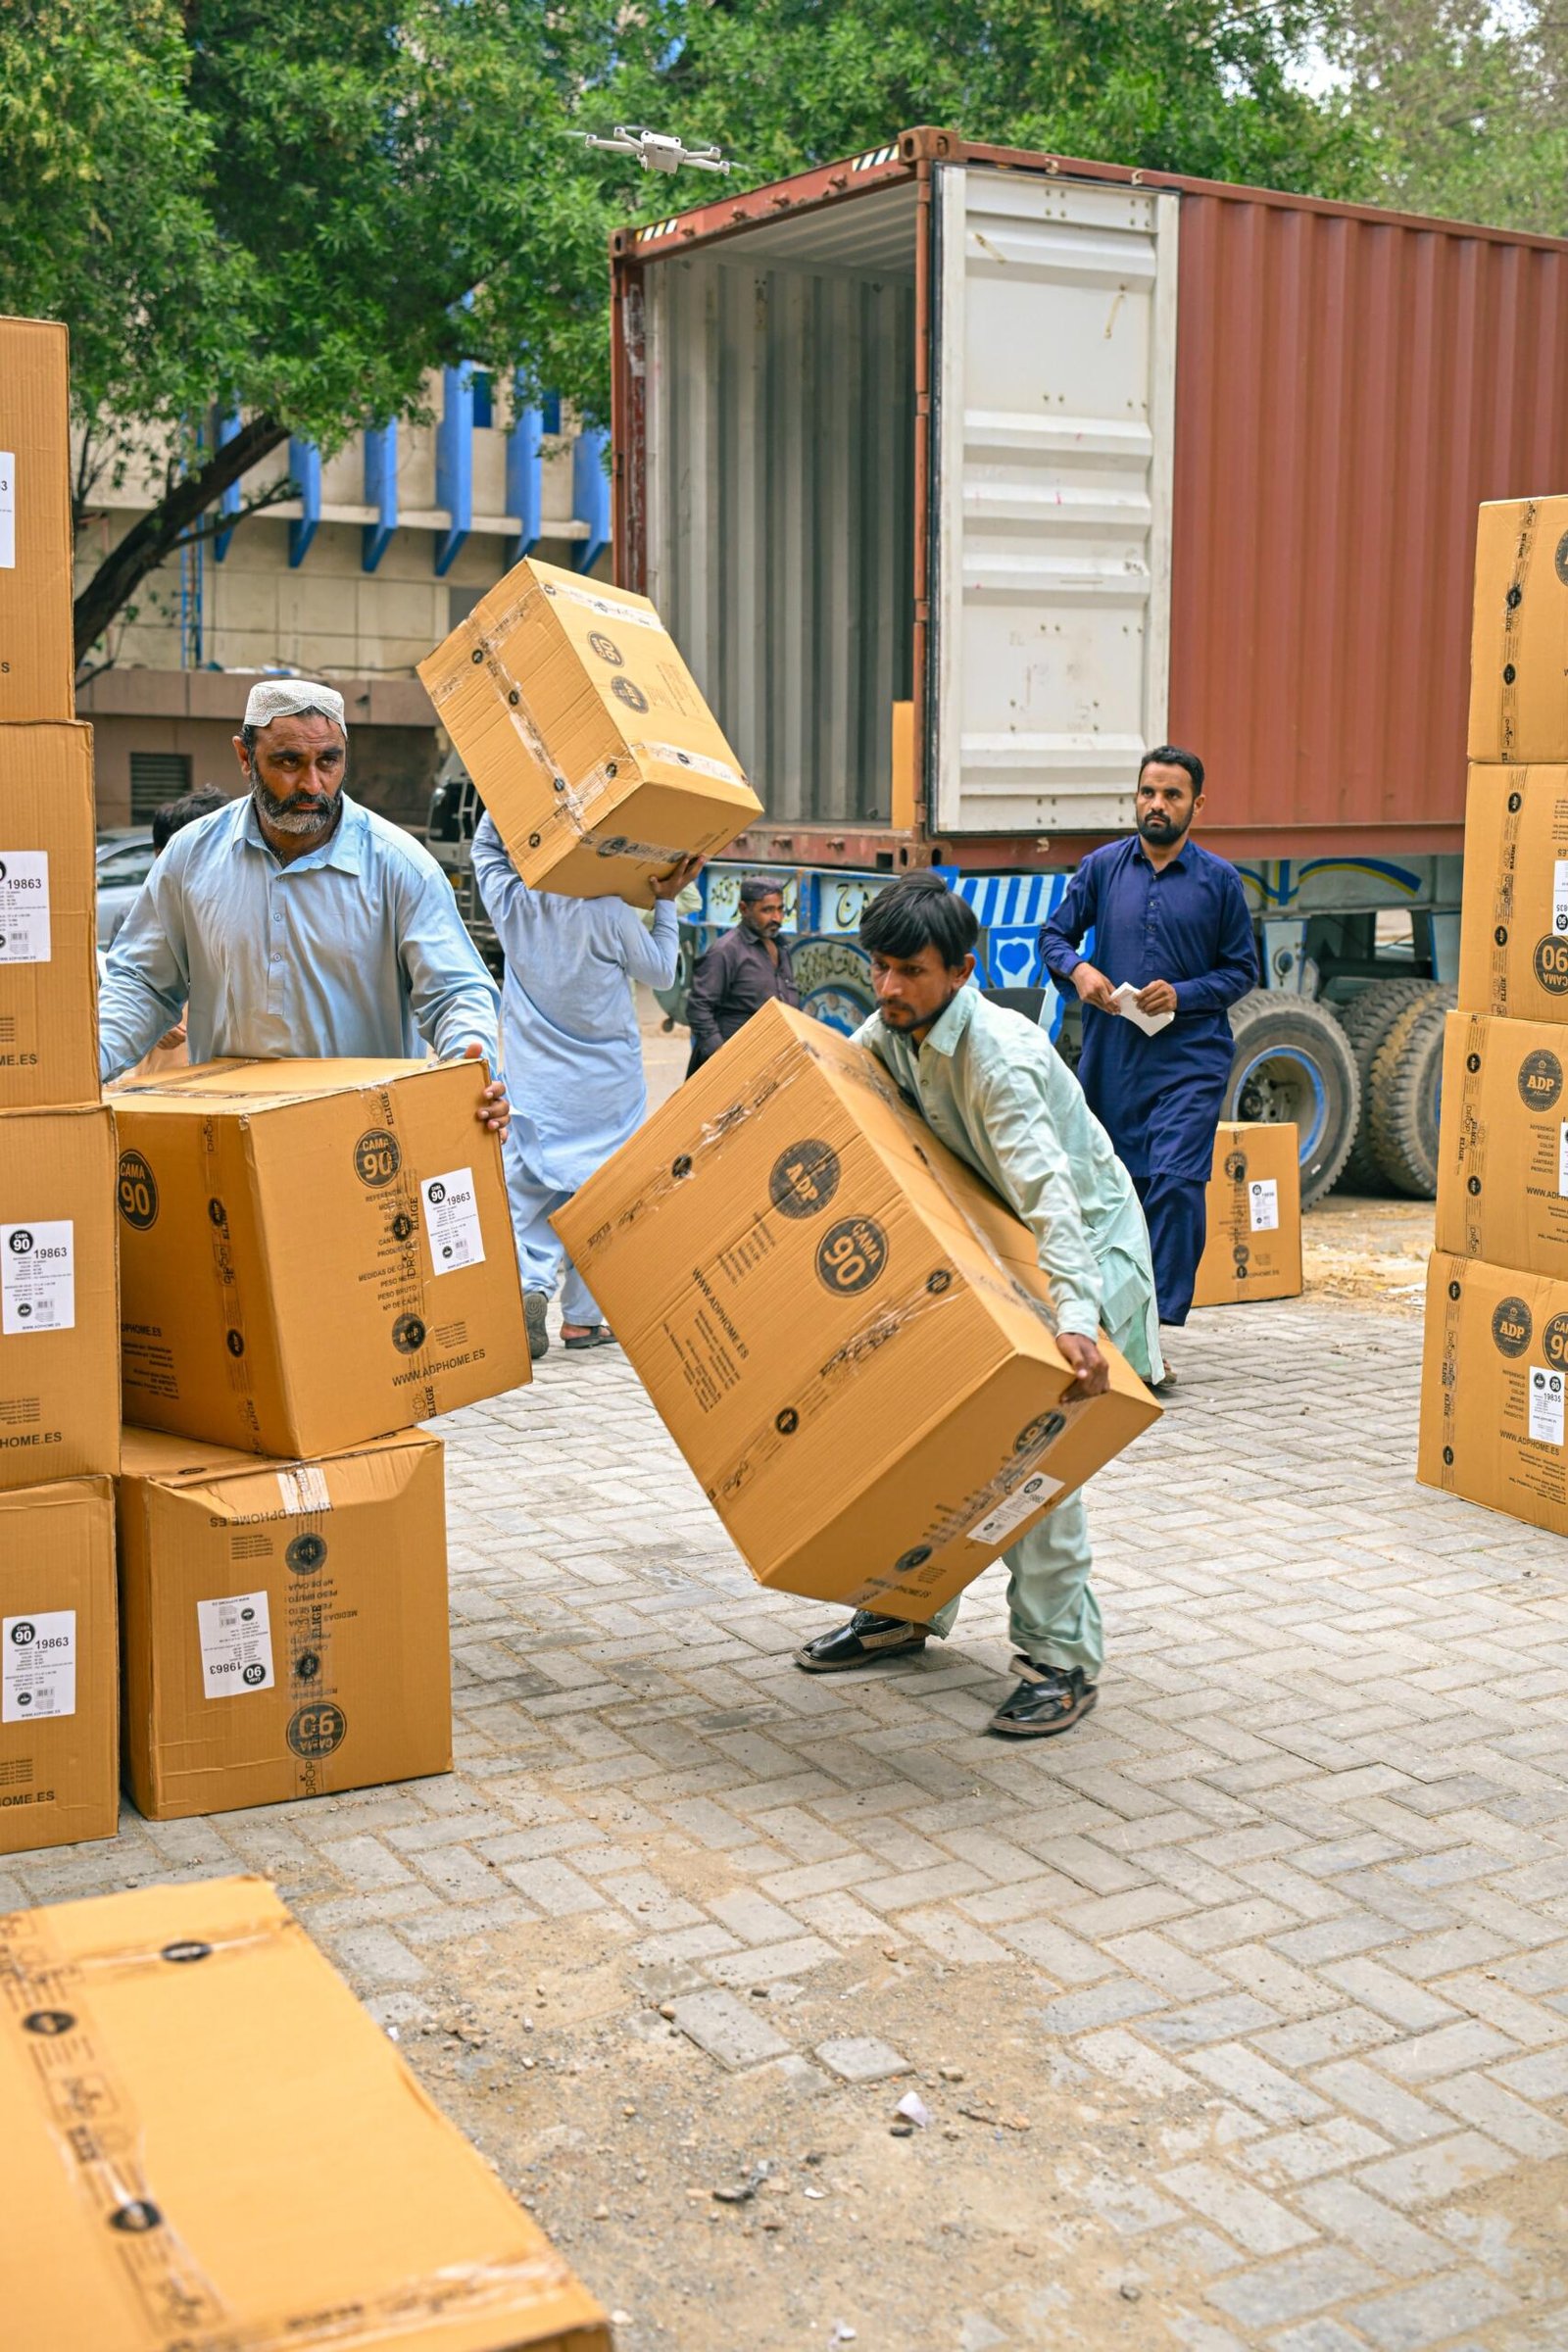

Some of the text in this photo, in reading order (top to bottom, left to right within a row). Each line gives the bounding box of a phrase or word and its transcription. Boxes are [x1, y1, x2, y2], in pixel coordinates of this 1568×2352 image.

[8, 878, 42, 890] 19863
[1542, 946, 1568, 973] 90
[1526, 1074, 1555, 1092] ADP
[381, 1091, 394, 1126] ELIGE
[120, 1162, 146, 1180] CAMA
[364, 1151, 393, 1179] 90
[785, 1162, 819, 1201] ADP
[121, 1182, 151, 1216] 90
[431, 1189, 444, 1202] 90
[447, 1191, 471, 1206] 19863
[410, 1197, 418, 1231] ELIGE
[13, 1238, 30, 1251] 90
[852, 1222, 881, 1265] CAMA
[33, 1248, 68, 1259] 19863
[405, 1241, 416, 1278] DROP
[823, 1236, 866, 1287] 90
[358, 1269, 386, 1282] MEDIDAS
[387, 1266, 397, 1275] DE
[380, 1278, 397, 1289] PESO
[377, 1285, 417, 1301] PESO BRUTO
[692, 1267, 750, 1360] WWW.ADPHOME.ES
[1499, 1321, 1525, 1340] ADP
[392, 1348, 487, 1387] WWW.ADPHOME.ES
[1551, 1381, 1560, 1391] 90
[425, 1386, 437, 1418] ELIGE
[1544, 1393, 1561, 1403] 19835
[1499, 1429, 1560, 1456] WWW.ADPHOME.ES
[288, 1590, 338, 1603] PESO BRUTO
[312, 1604, 322, 1639] ELIGE
[15, 1630, 32, 1642] 90
[35, 1637, 70, 1649] 19863
[210, 1662, 242, 1675] 19863
[246, 1666, 262, 1679] 90
[306, 1760, 317, 1796] DROP
[0, 1790, 55, 1807] OME.ES
